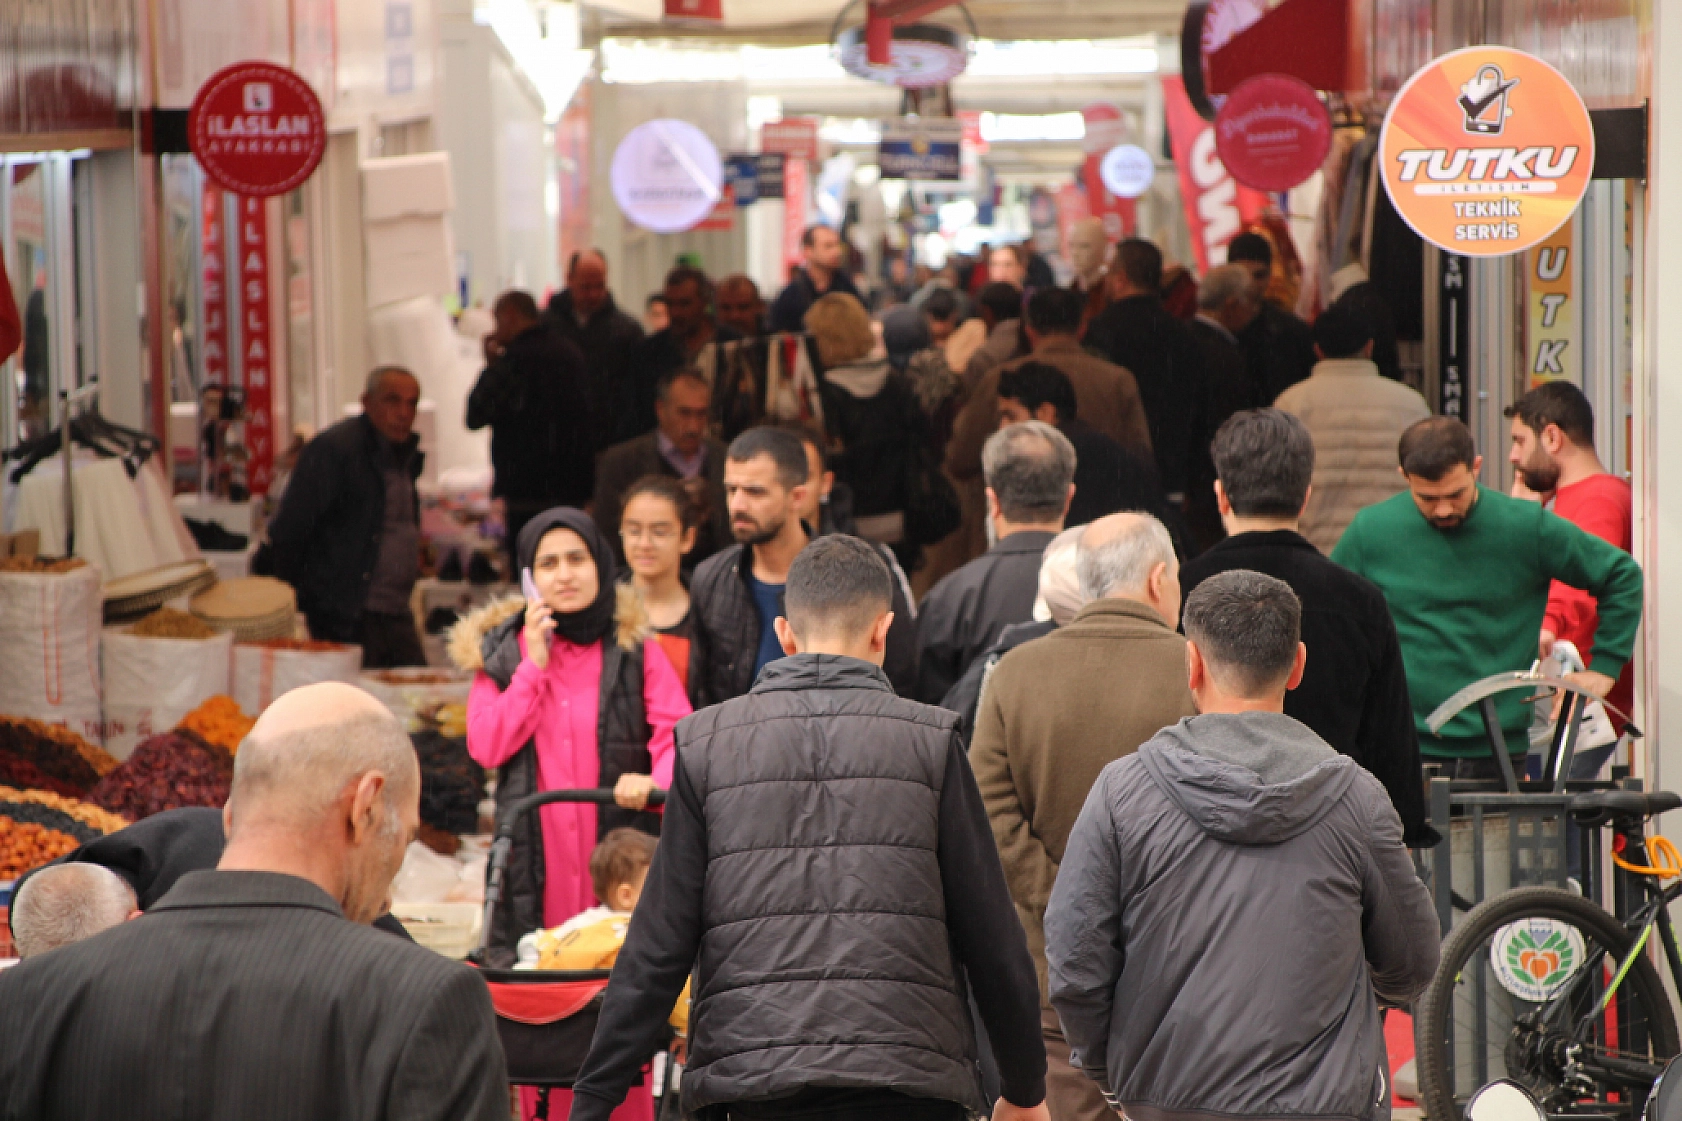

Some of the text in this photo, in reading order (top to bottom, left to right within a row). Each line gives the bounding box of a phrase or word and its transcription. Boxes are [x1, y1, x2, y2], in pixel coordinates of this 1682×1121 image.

[1397, 146, 1580, 182] TUTKU
[1453, 196, 1521, 217] TEKNİK
[1455, 220, 1519, 240] SERVİS
[1534, 247, 1569, 374] UTK
